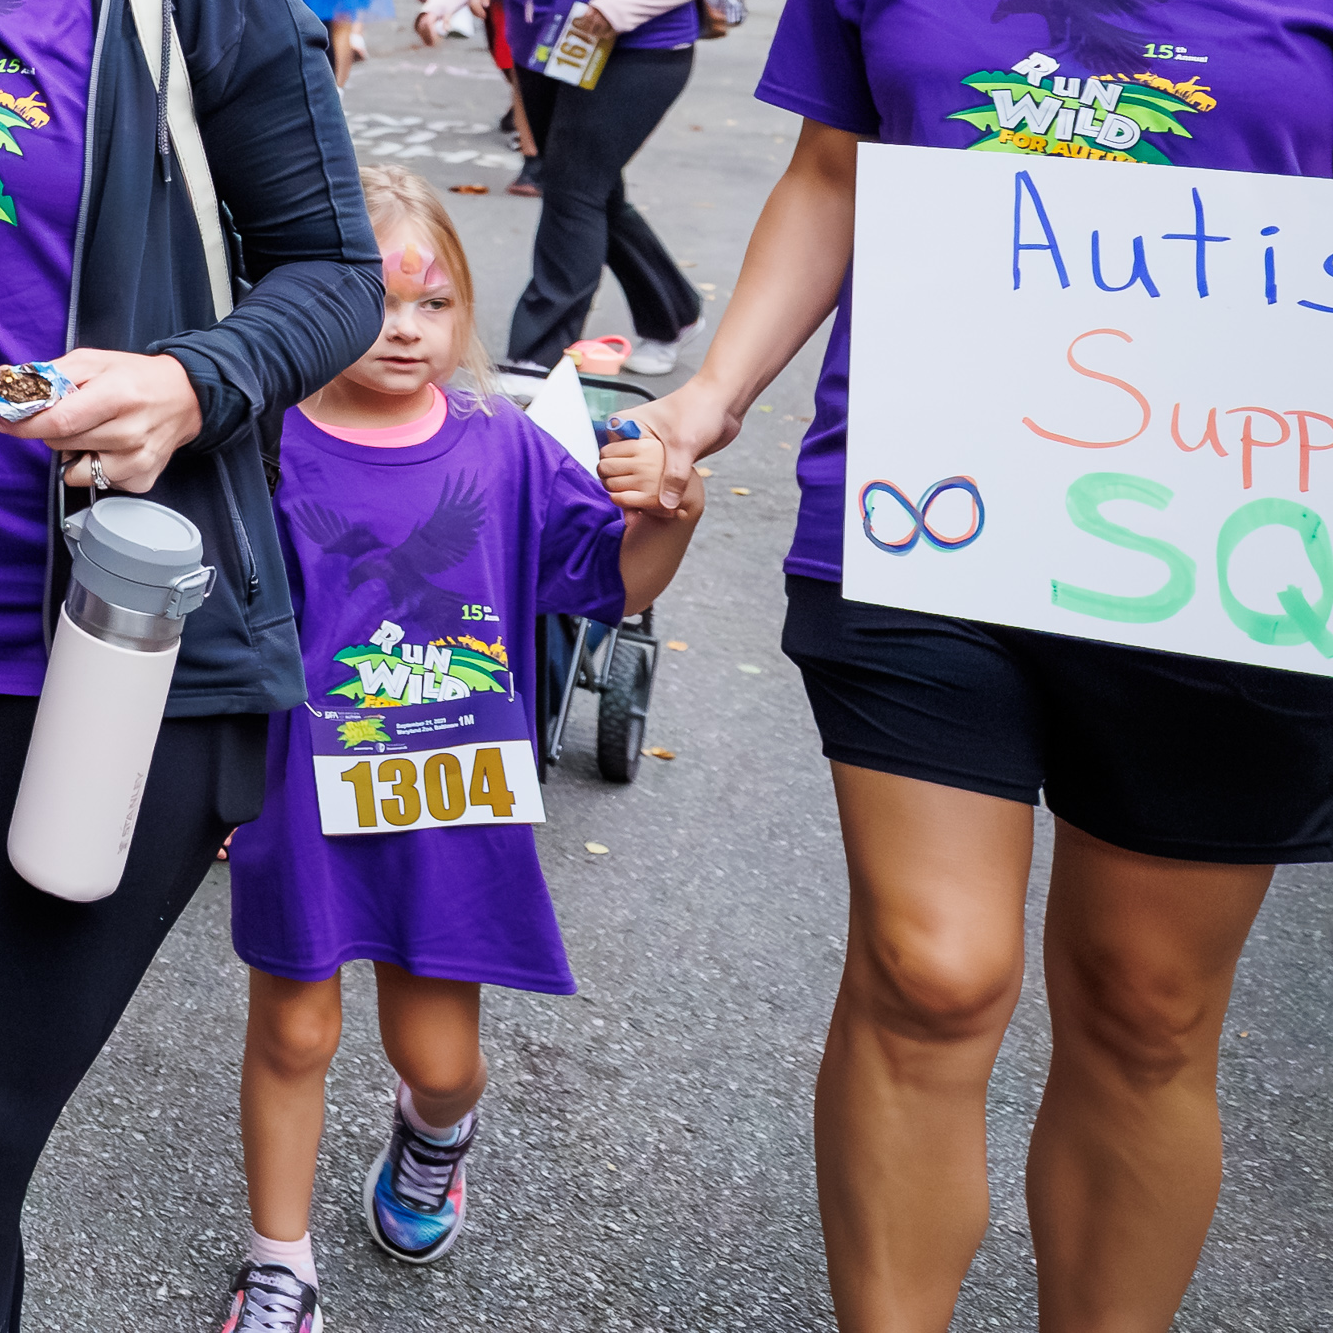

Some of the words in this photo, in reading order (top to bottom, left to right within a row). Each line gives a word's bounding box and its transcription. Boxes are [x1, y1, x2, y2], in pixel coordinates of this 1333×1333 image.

[1142, 43, 1174, 60] 15
[991, 89, 1141, 150] WILD
[998, 129, 1047, 153] FOR
[1052, 142, 1148, 164] AUTI
[1021, 328, 1333, 492] Supp
[1050, 471, 1333, 659] SQ
[461, 604, 483, 621] 15
[358, 660, 470, 705] WILD
[458, 714, 475, 727] 1M
[122, 772, 144, 837] STANLEY
[340, 748, 516, 828] 1304
